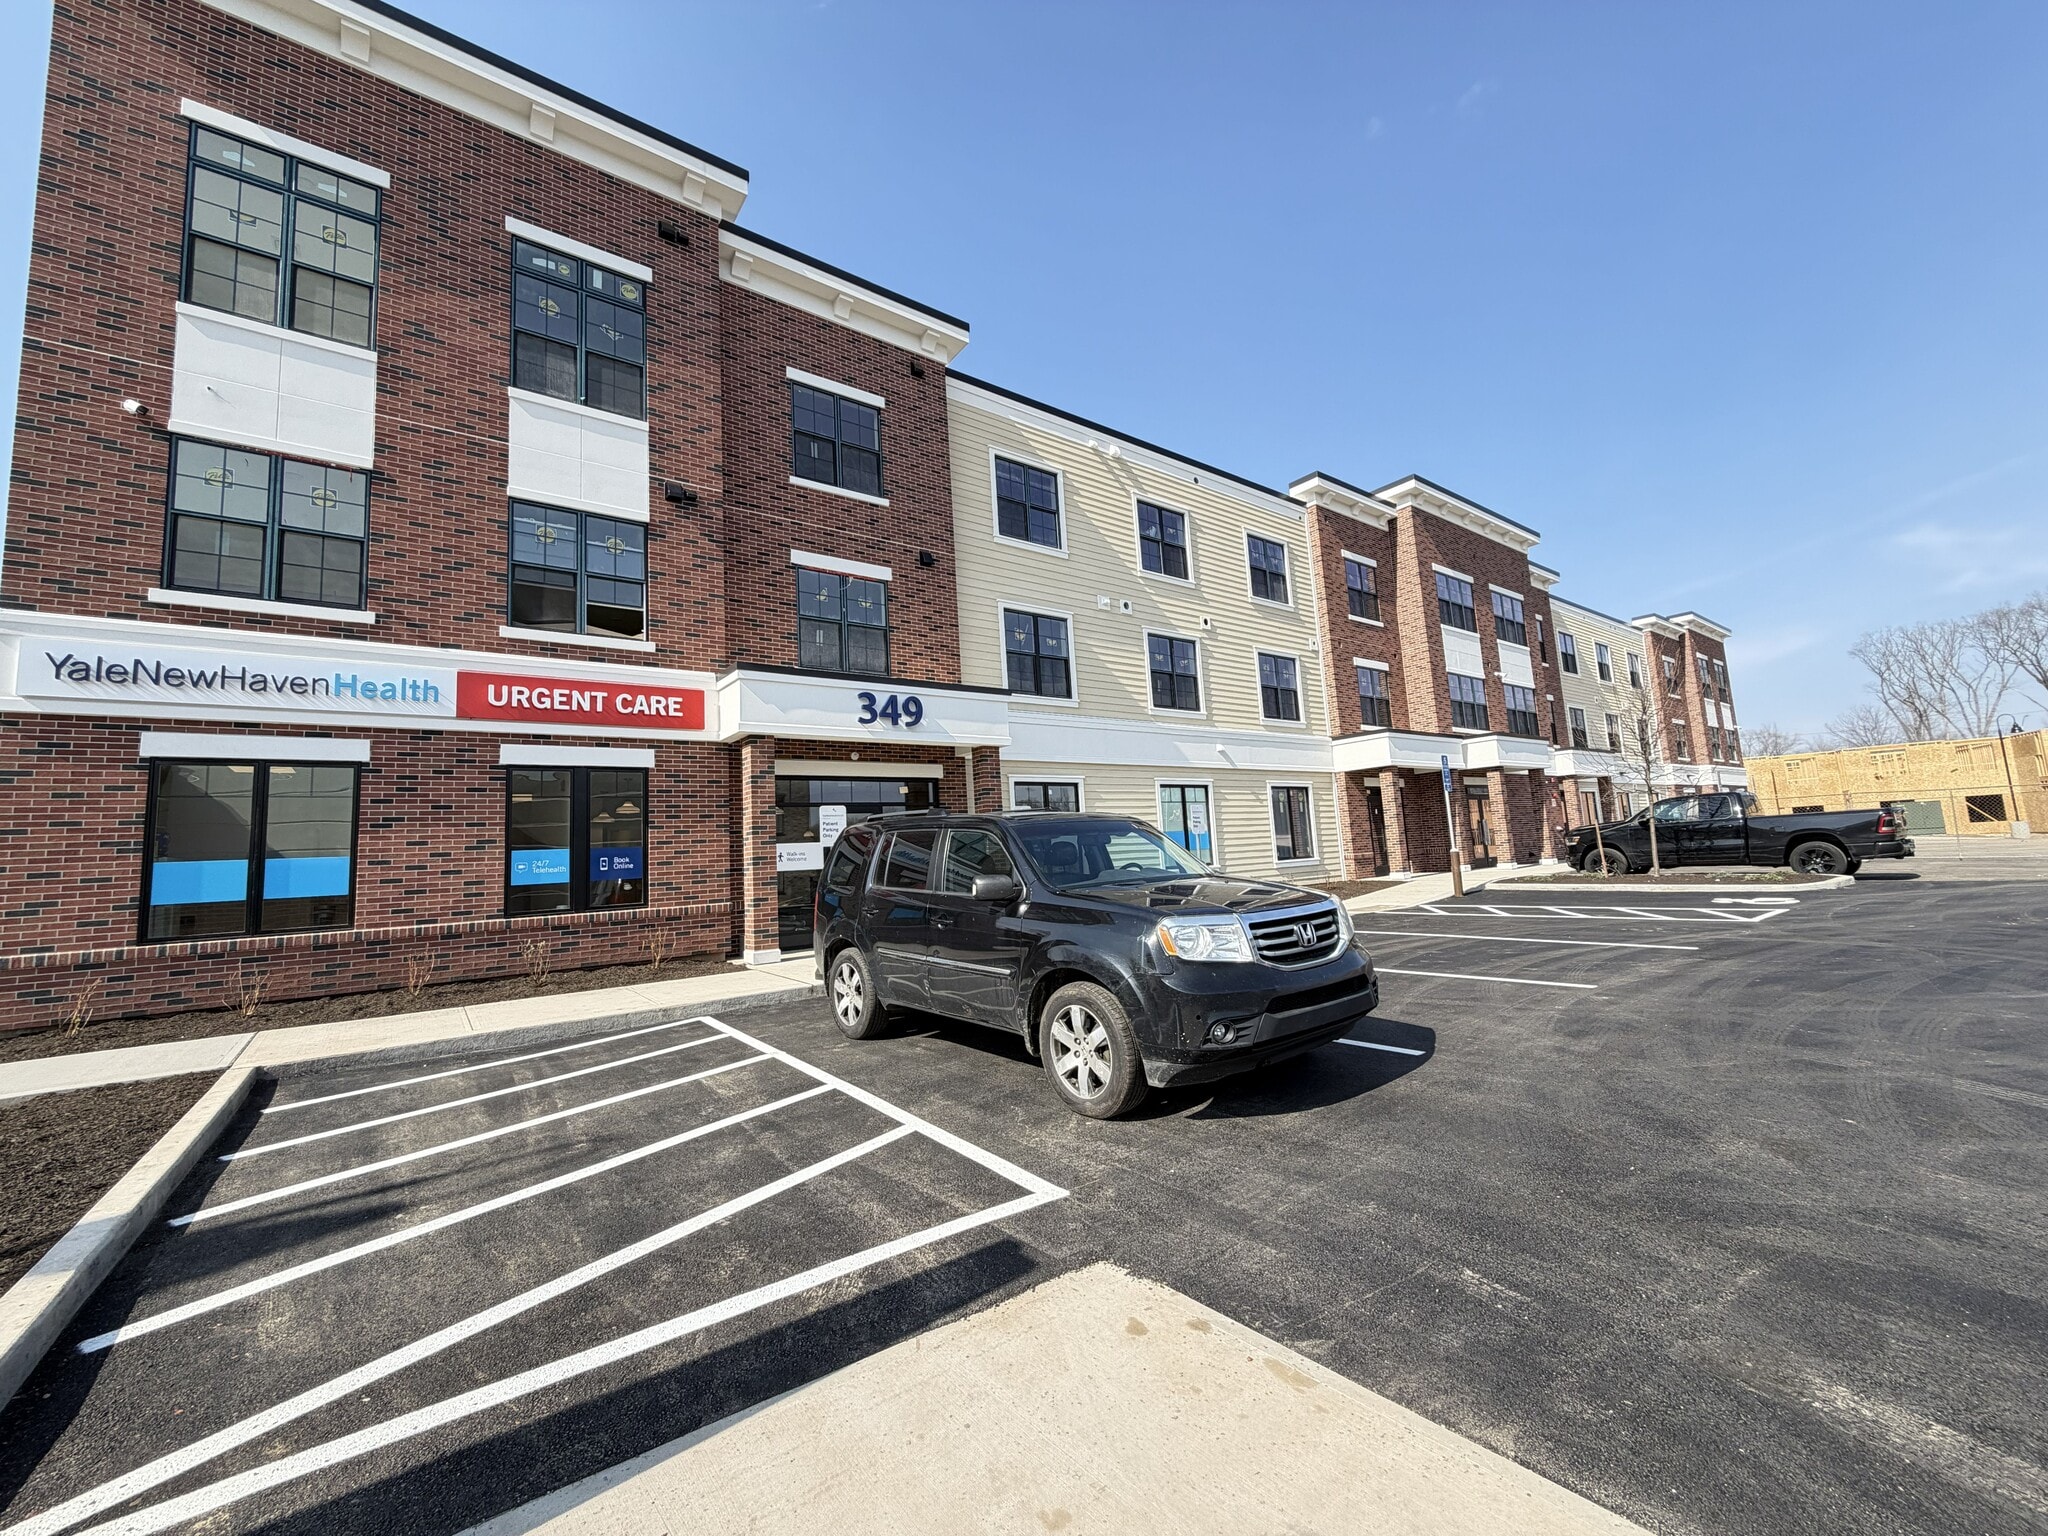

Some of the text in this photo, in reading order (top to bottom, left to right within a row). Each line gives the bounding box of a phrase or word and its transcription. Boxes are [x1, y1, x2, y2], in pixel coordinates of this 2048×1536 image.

[487, 684, 683, 717] URGENT CARE
[857, 691, 924, 727] 349
[532, 866, 567, 874] Telehealth
[613, 862, 634, 870] Online
